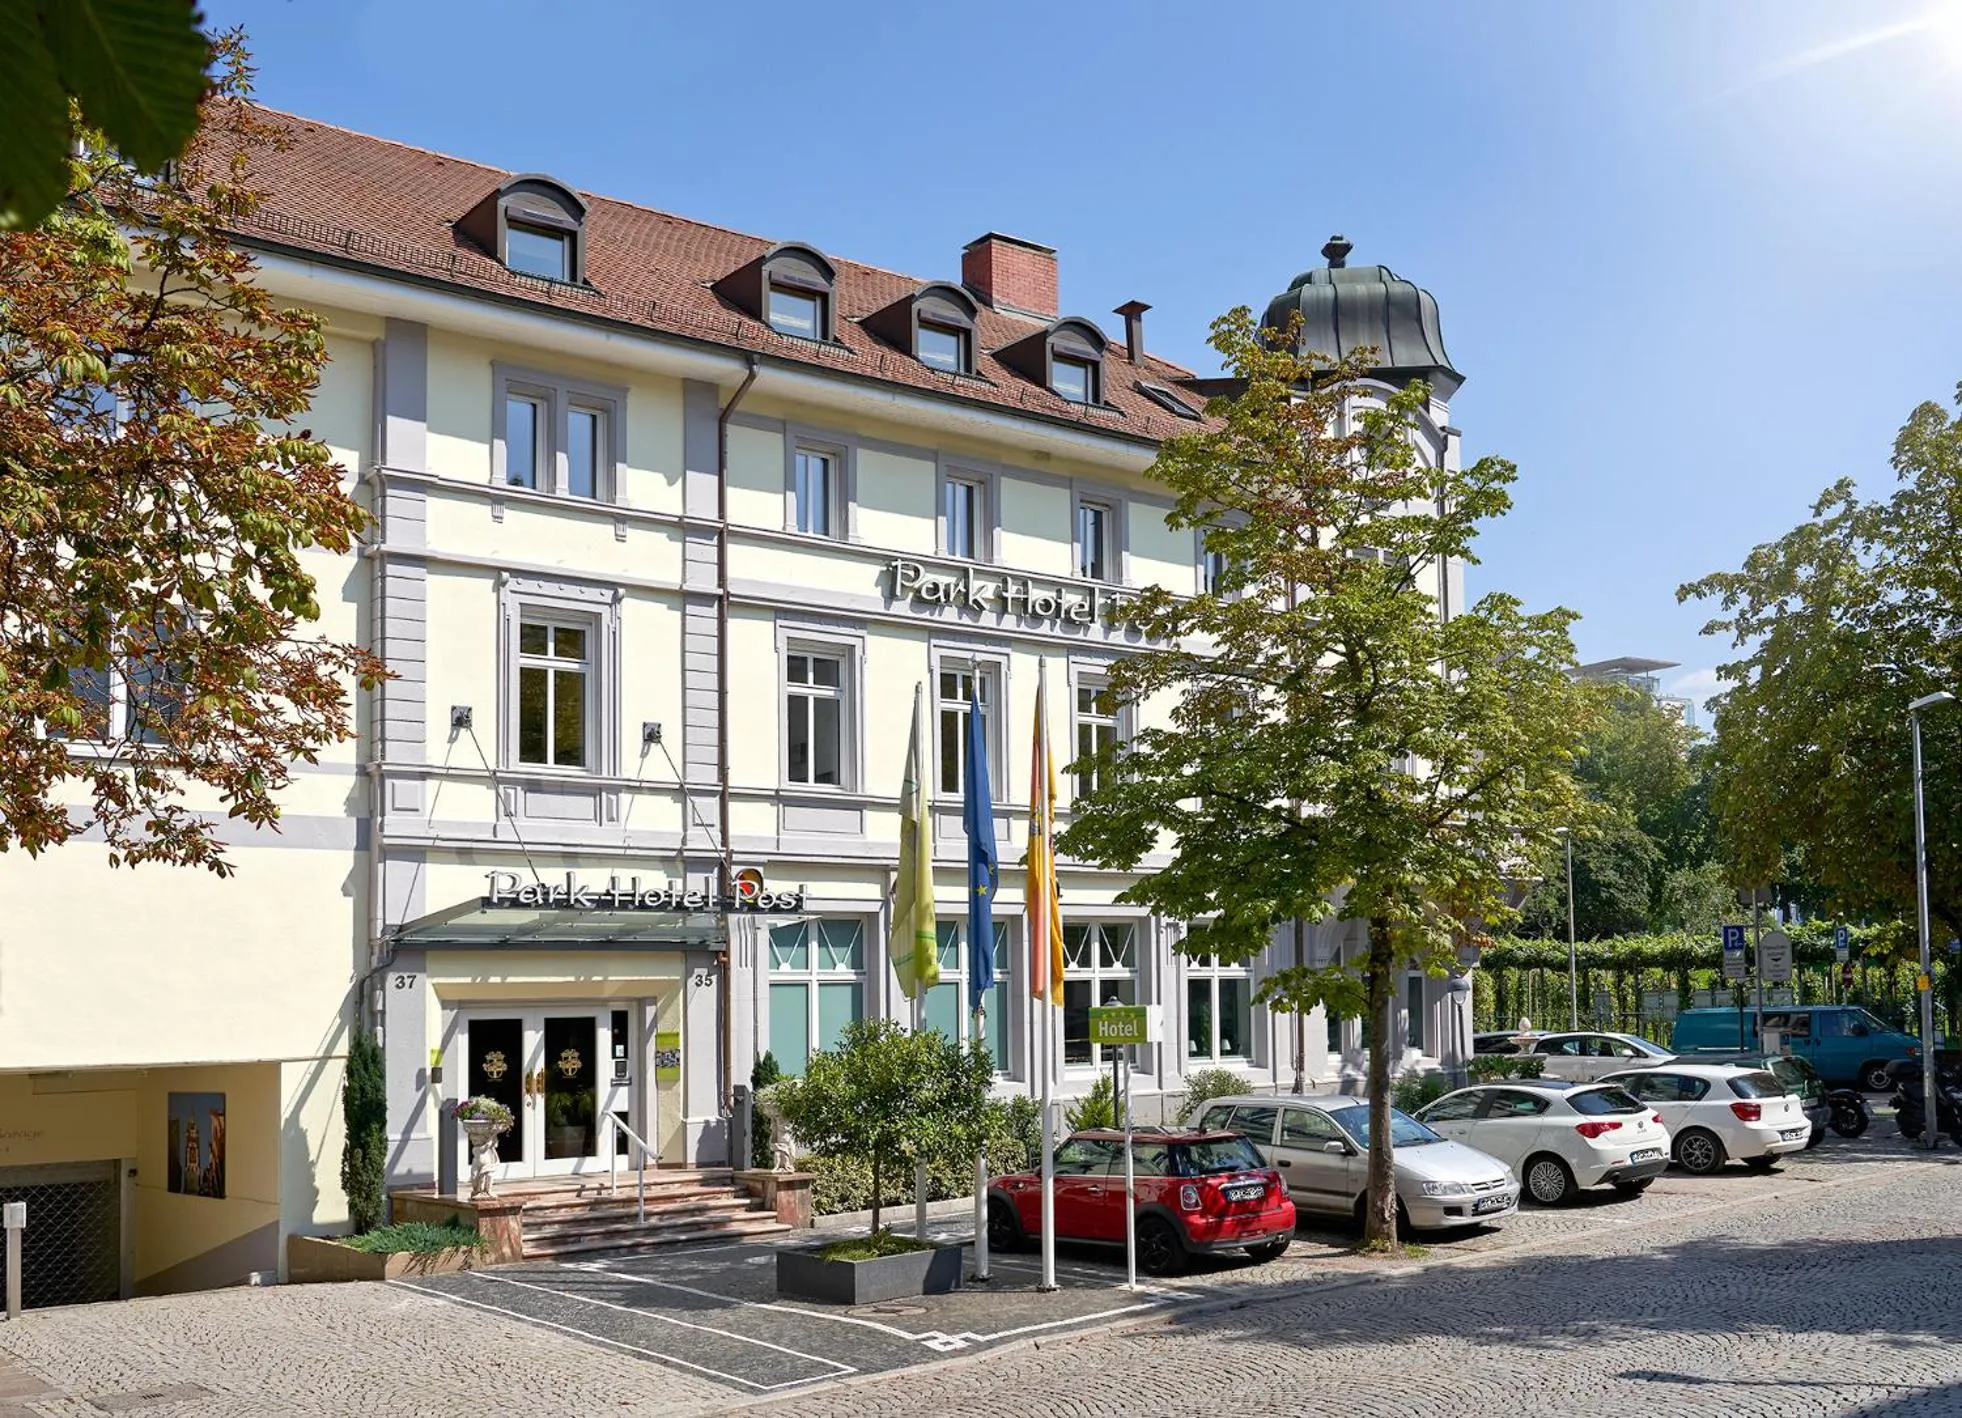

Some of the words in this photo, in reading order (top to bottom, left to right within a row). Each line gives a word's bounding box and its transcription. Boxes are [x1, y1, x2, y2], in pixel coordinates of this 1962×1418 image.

[891, 558, 991, 612] Park
[1001, 576, 1100, 625] Hotel
[484, 870, 596, 908] Park
[608, 875, 714, 908] Hotel
[731, 879, 812, 909] Post
[1727, 928, 1740, 948] P
[394, 974, 417, 990] 37
[694, 974, 714, 987] 35
[1098, 1020, 1139, 1037] Hotel
